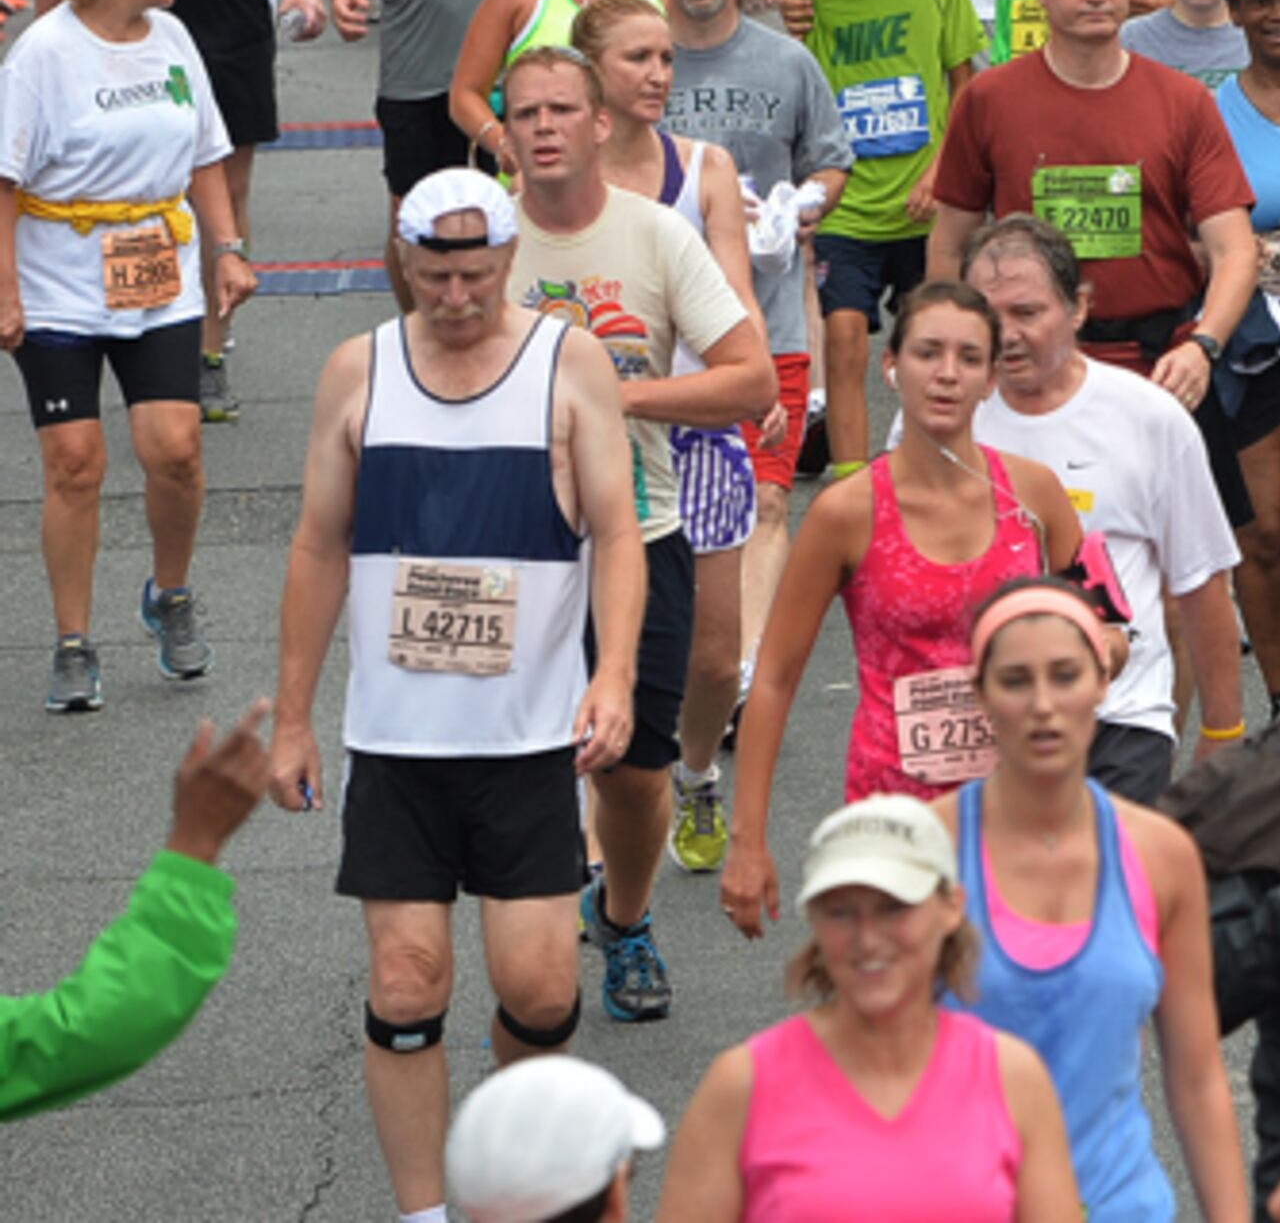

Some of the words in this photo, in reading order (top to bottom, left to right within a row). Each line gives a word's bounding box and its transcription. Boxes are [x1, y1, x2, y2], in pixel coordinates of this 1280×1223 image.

[832, 12, 911, 67] NIKE
[1063, 206, 1130, 231] 22470
[112, 264, 127, 286] H
[403, 609, 415, 638] L
[423, 611, 504, 645] 42715
[910, 724, 931, 752] G
[941, 719, 995, 750] 275
